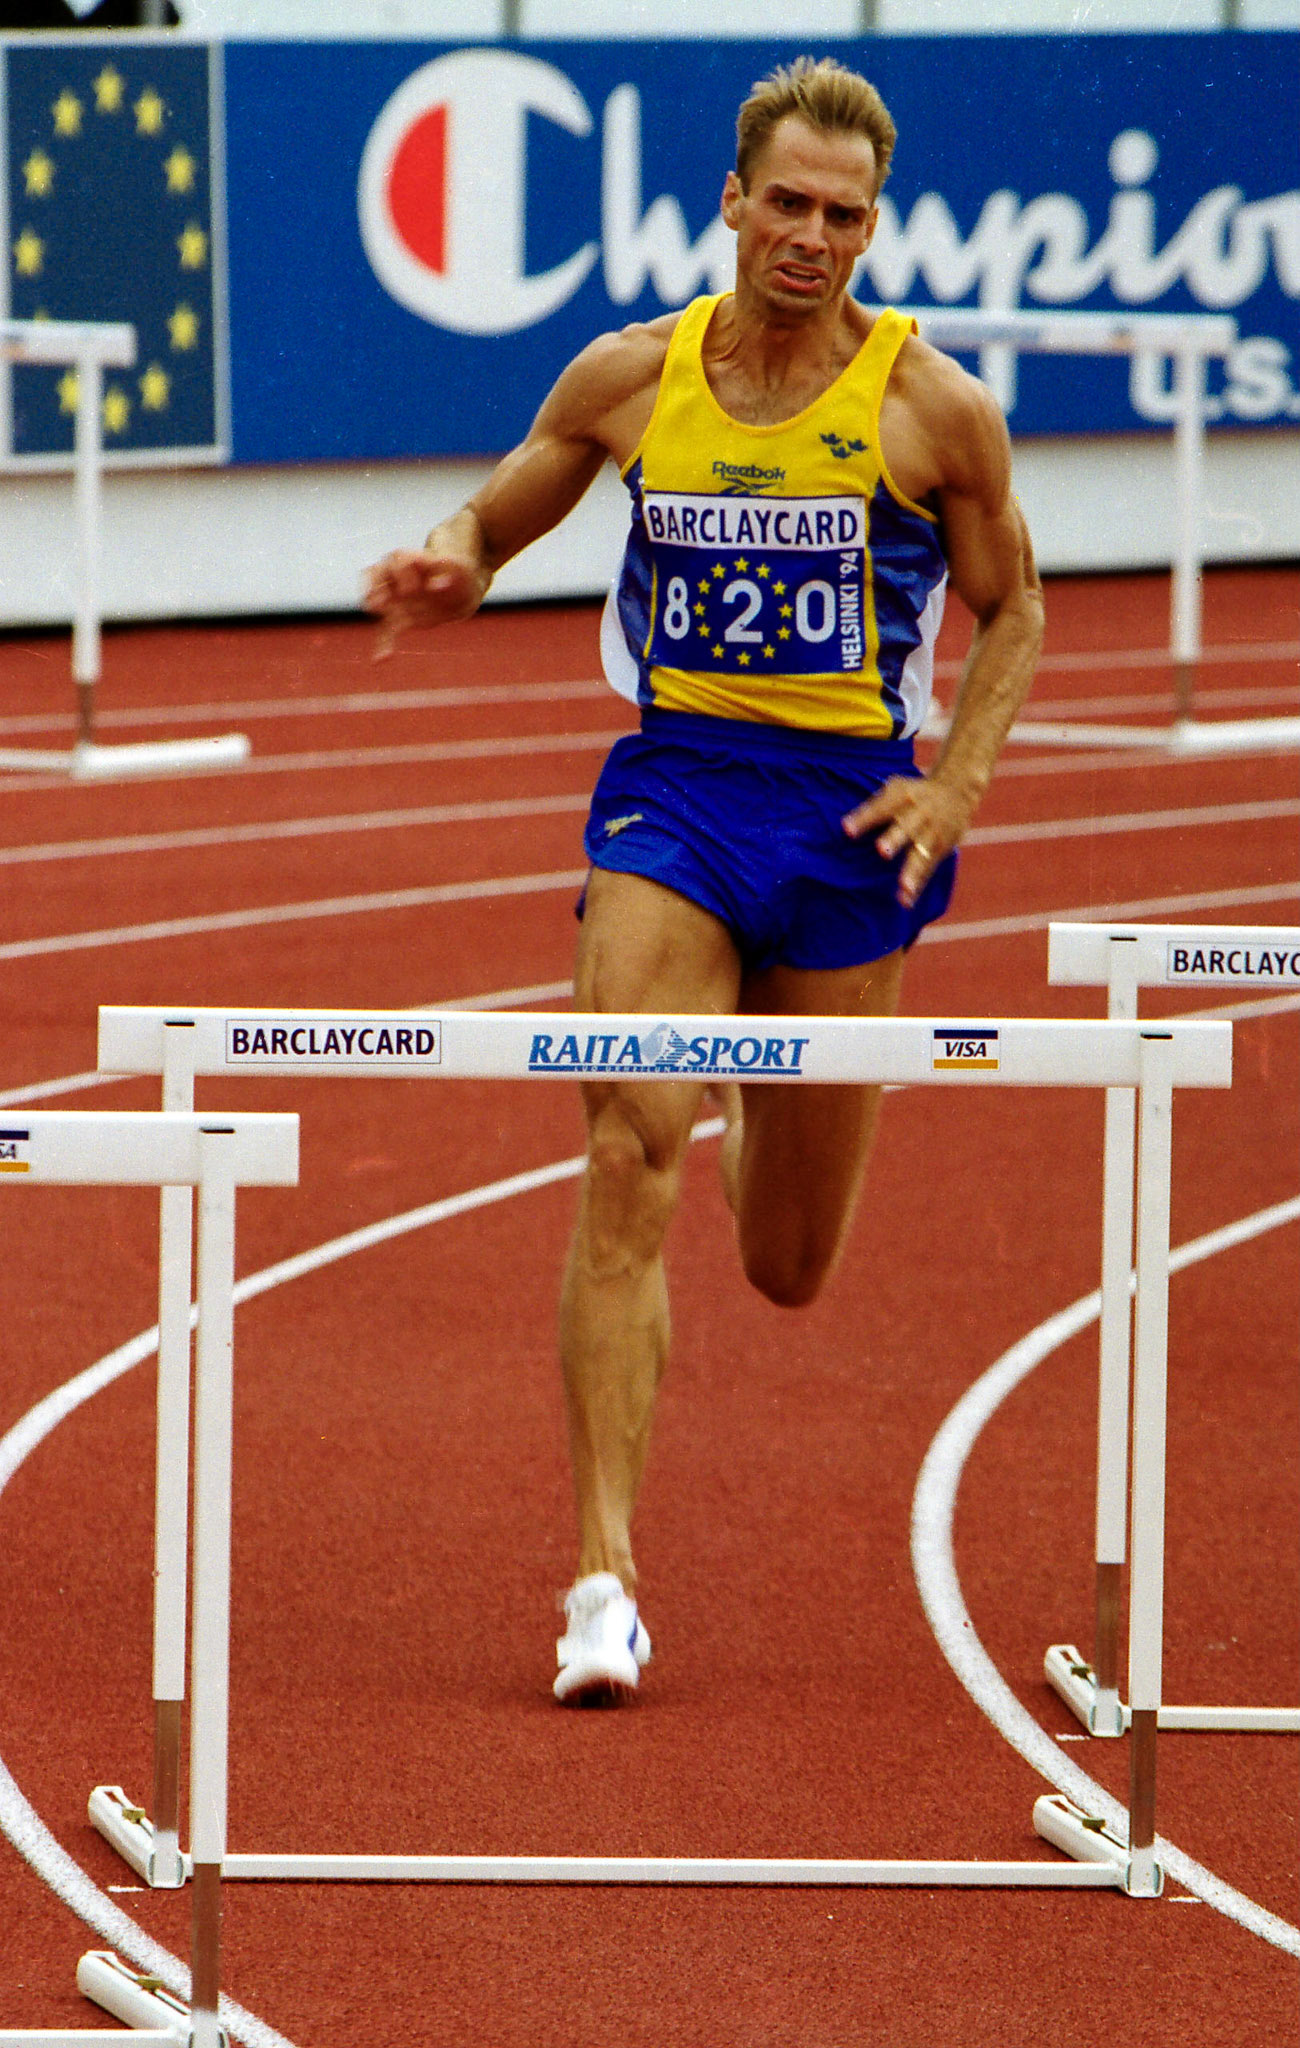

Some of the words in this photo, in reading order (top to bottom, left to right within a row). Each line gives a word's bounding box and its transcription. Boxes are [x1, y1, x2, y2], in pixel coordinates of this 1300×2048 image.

[712, 461, 786, 480] Reebok
[648, 505, 858, 545] BARCLAYCARD
[840, 551, 859, 579] '94
[840, 584, 862, 669] HELSINKI
[233, 1029, 435, 1055] BARCLAYCARD
[529, 1035, 643, 1064] RAITA
[687, 1037, 809, 1067] SPORT
[945, 1042, 987, 1057] VISA
